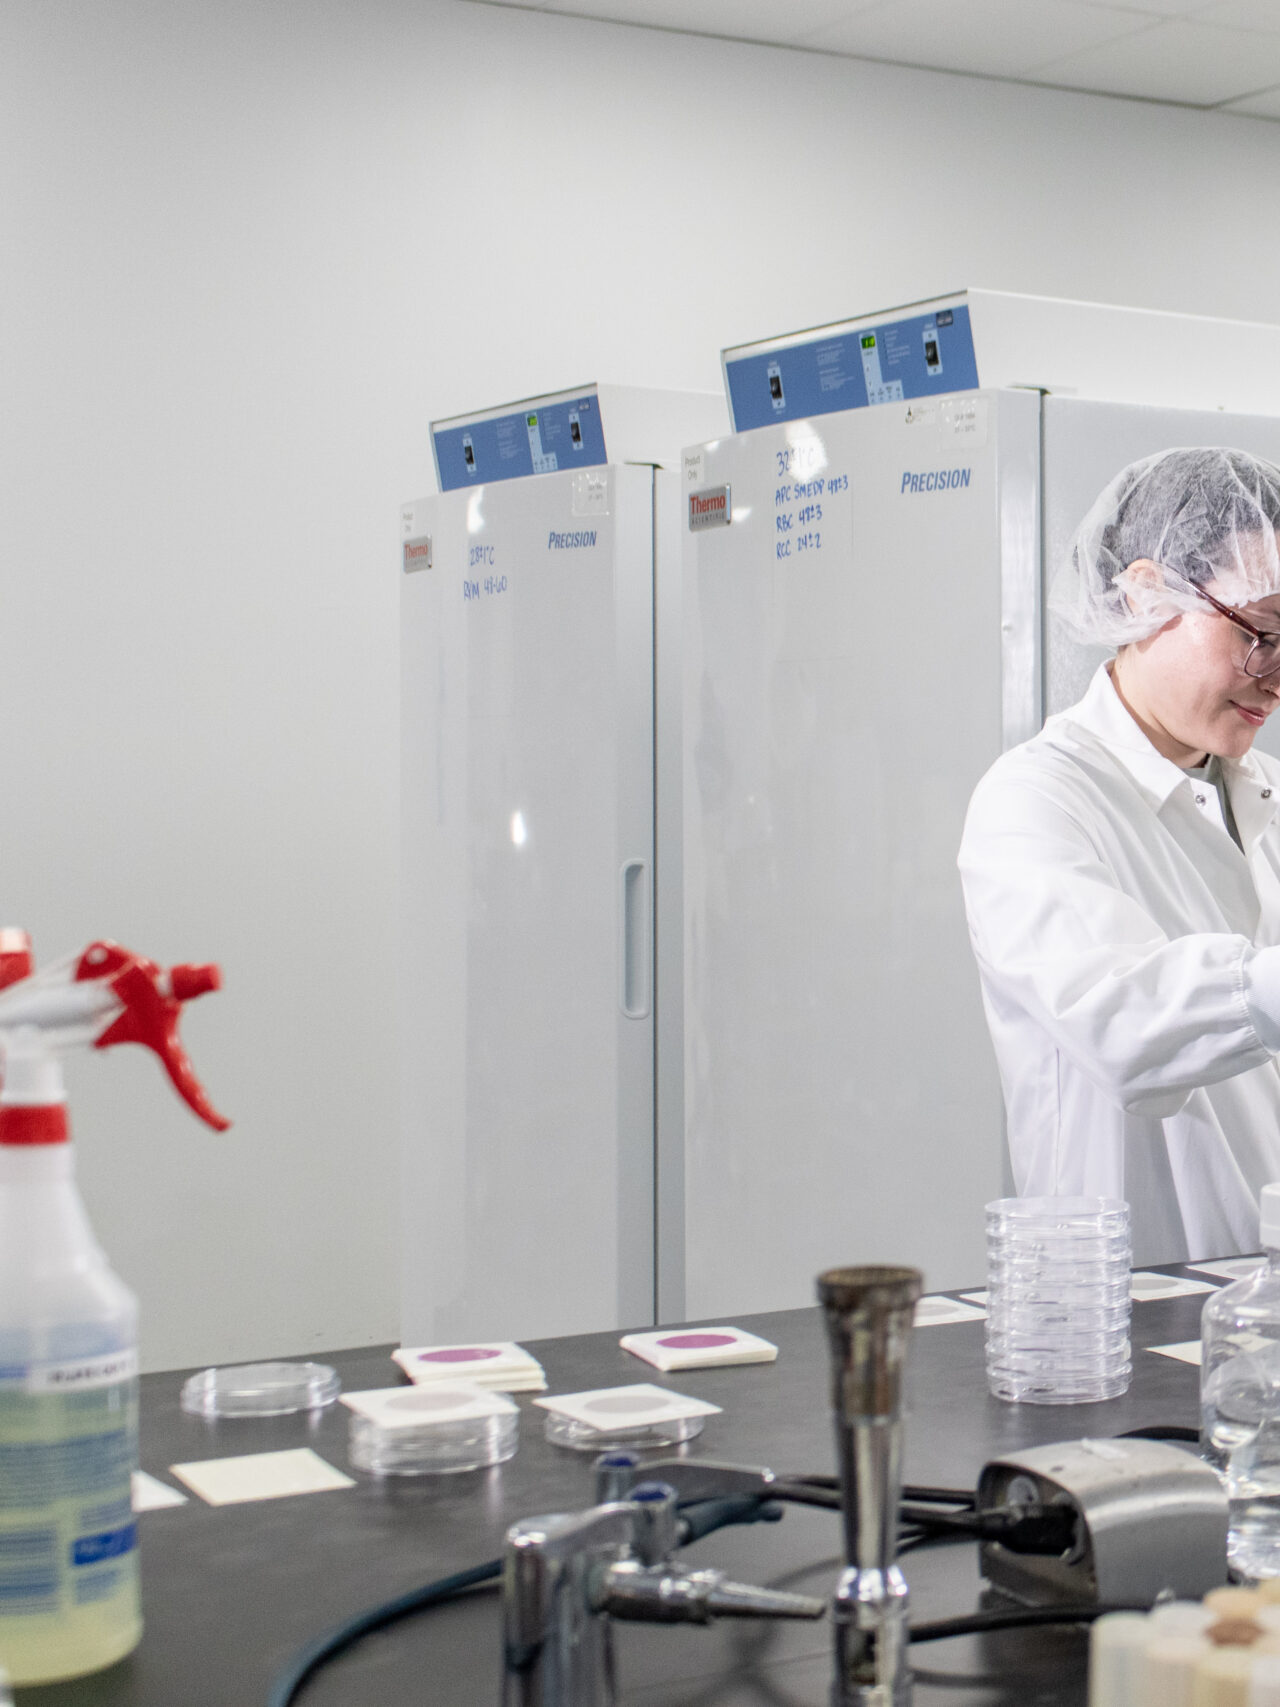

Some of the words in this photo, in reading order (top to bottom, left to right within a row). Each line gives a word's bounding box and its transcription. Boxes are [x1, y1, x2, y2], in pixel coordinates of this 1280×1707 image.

[901, 467, 971, 494] PRECISION
[690, 496, 726, 515] Thermo
[548, 530, 598, 549] PRECISION
[404, 543, 429, 561] Thermo
